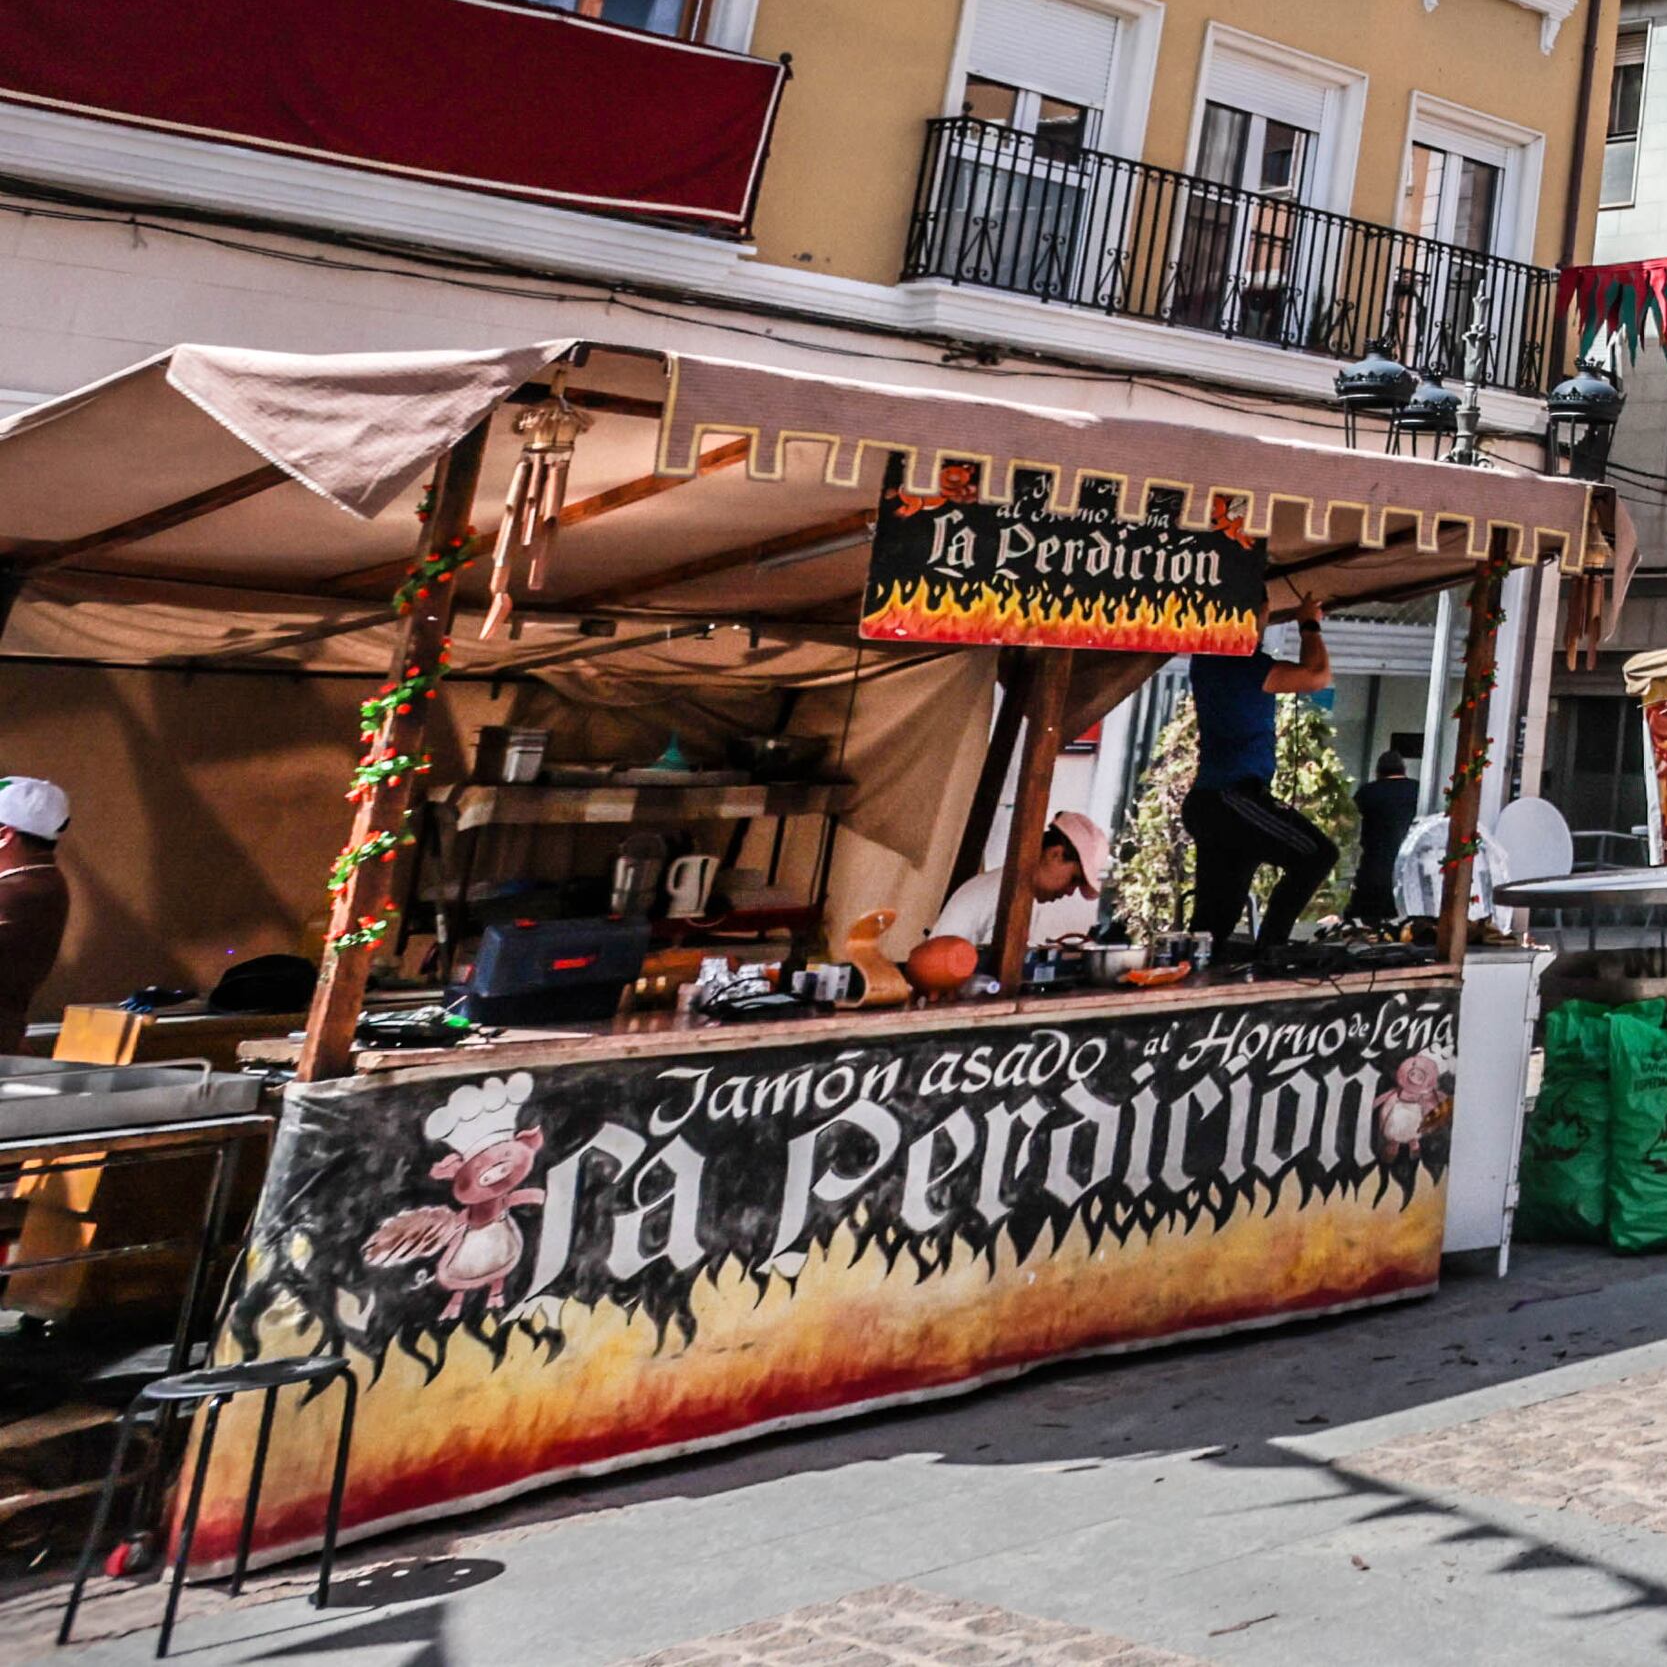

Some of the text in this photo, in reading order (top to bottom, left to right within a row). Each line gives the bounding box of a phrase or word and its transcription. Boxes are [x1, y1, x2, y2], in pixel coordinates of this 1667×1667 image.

[926, 509, 1222, 586] La Perdición
[649, 992, 1455, 1135] Jamón asado al Horno de Leña
[515, 1053, 1382, 1312] La Perdición
